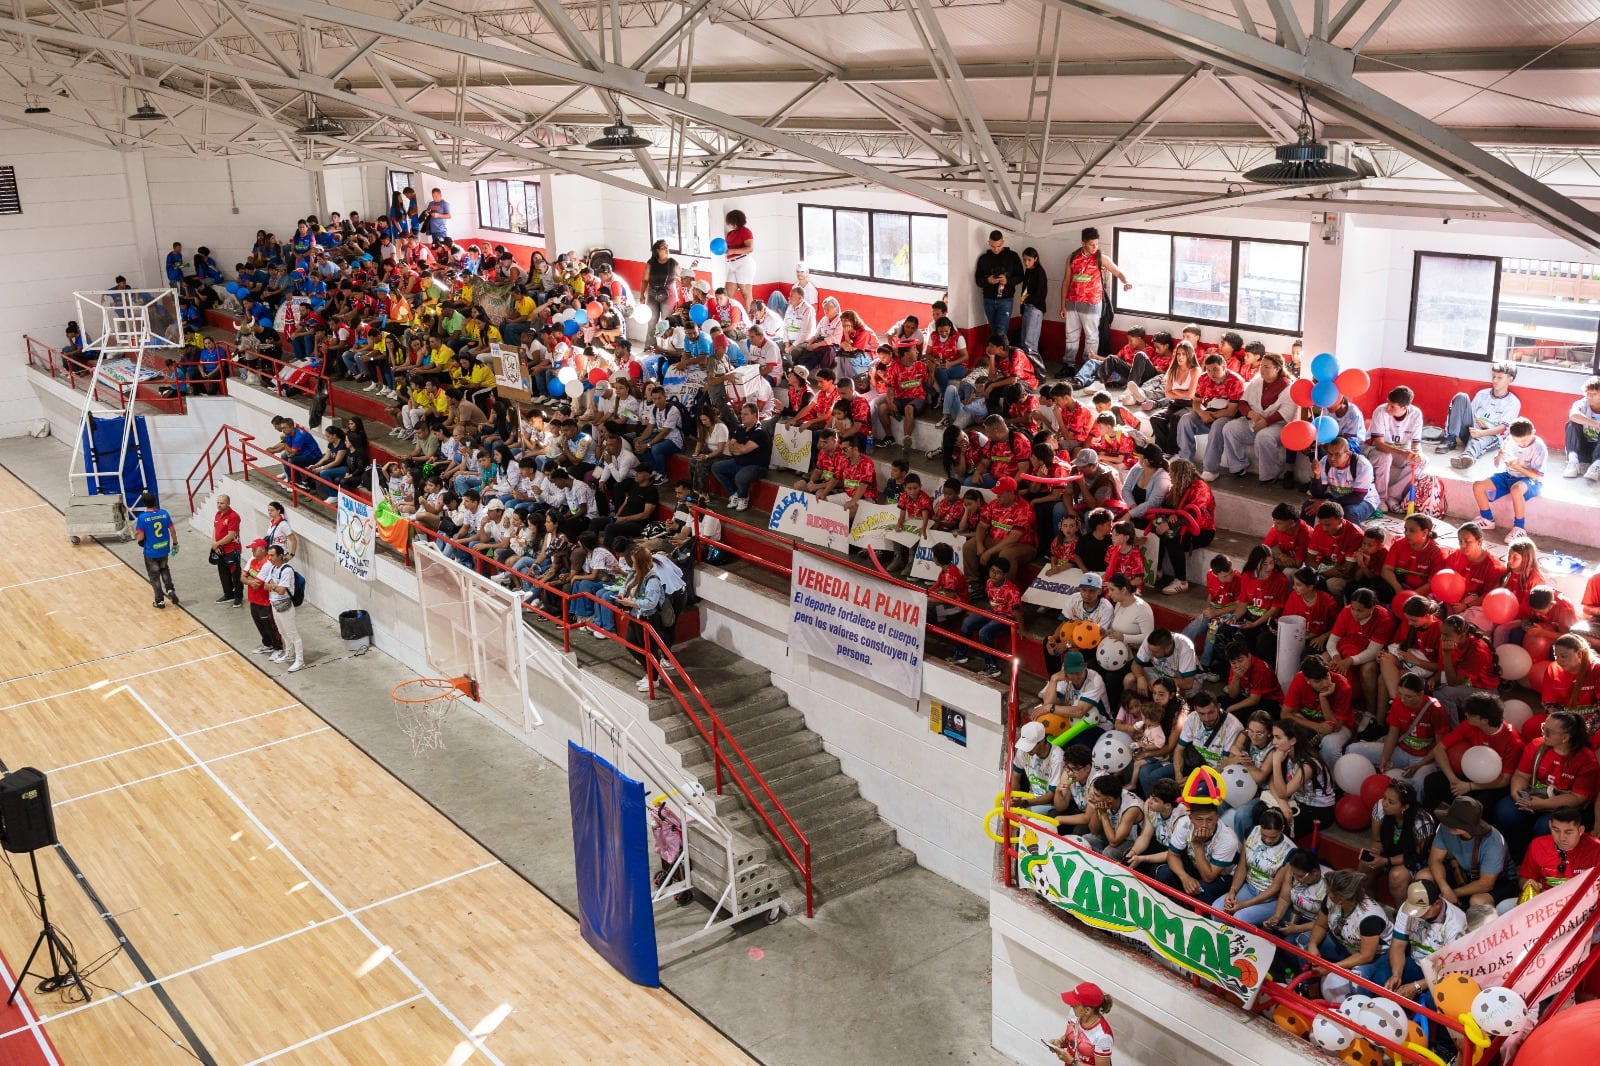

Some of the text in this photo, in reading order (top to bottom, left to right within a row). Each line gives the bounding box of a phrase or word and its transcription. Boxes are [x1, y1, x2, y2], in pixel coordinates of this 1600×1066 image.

[1391, 434, 1401, 443] 10
[153, 521, 163, 538] 2
[806, 513, 849, 538] RESPETO
[798, 566, 920, 628] VEREDA LA PLAYA
[1253, 598, 1263, 608] 10
[794, 591, 920, 650] El deporte fortalece el cuerpo,
[794, 610, 918, 667] pero los valores construyen la
[837, 643, 873, 666] persona.
[1052, 855, 1242, 979] YARUMAL
[1438, 924, 1519, 966] YARUMAL
